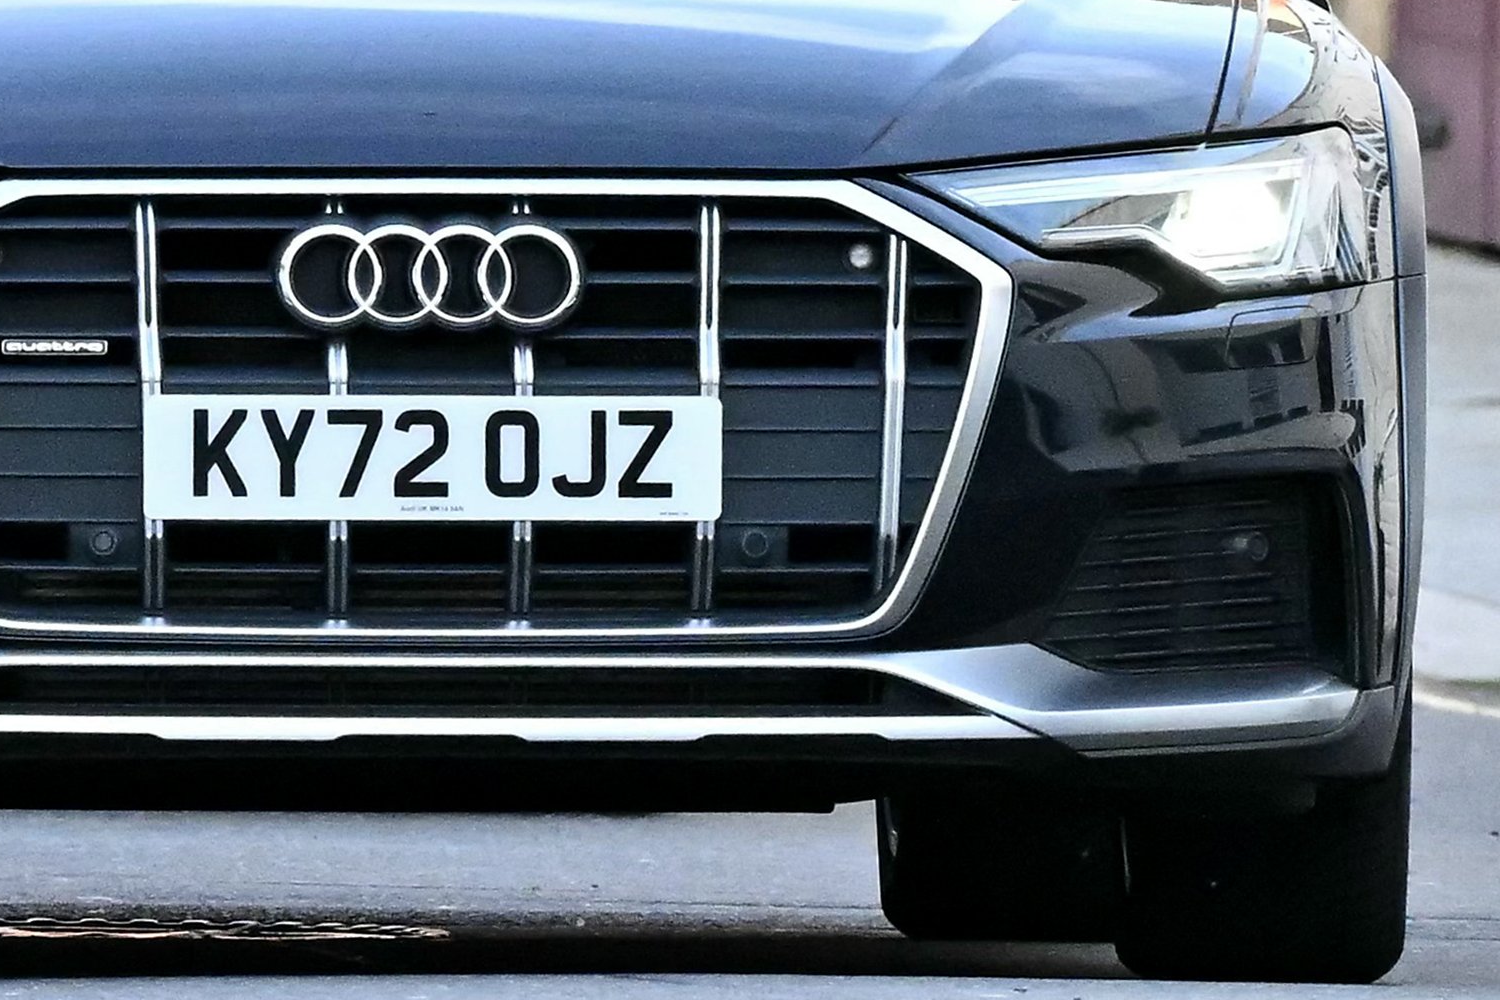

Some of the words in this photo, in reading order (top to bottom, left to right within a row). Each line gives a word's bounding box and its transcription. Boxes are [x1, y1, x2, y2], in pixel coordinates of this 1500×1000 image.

[5, 341, 103, 353] quattro
[192, 408, 450, 498] KY72
[484, 409, 673, 499] OJZ
